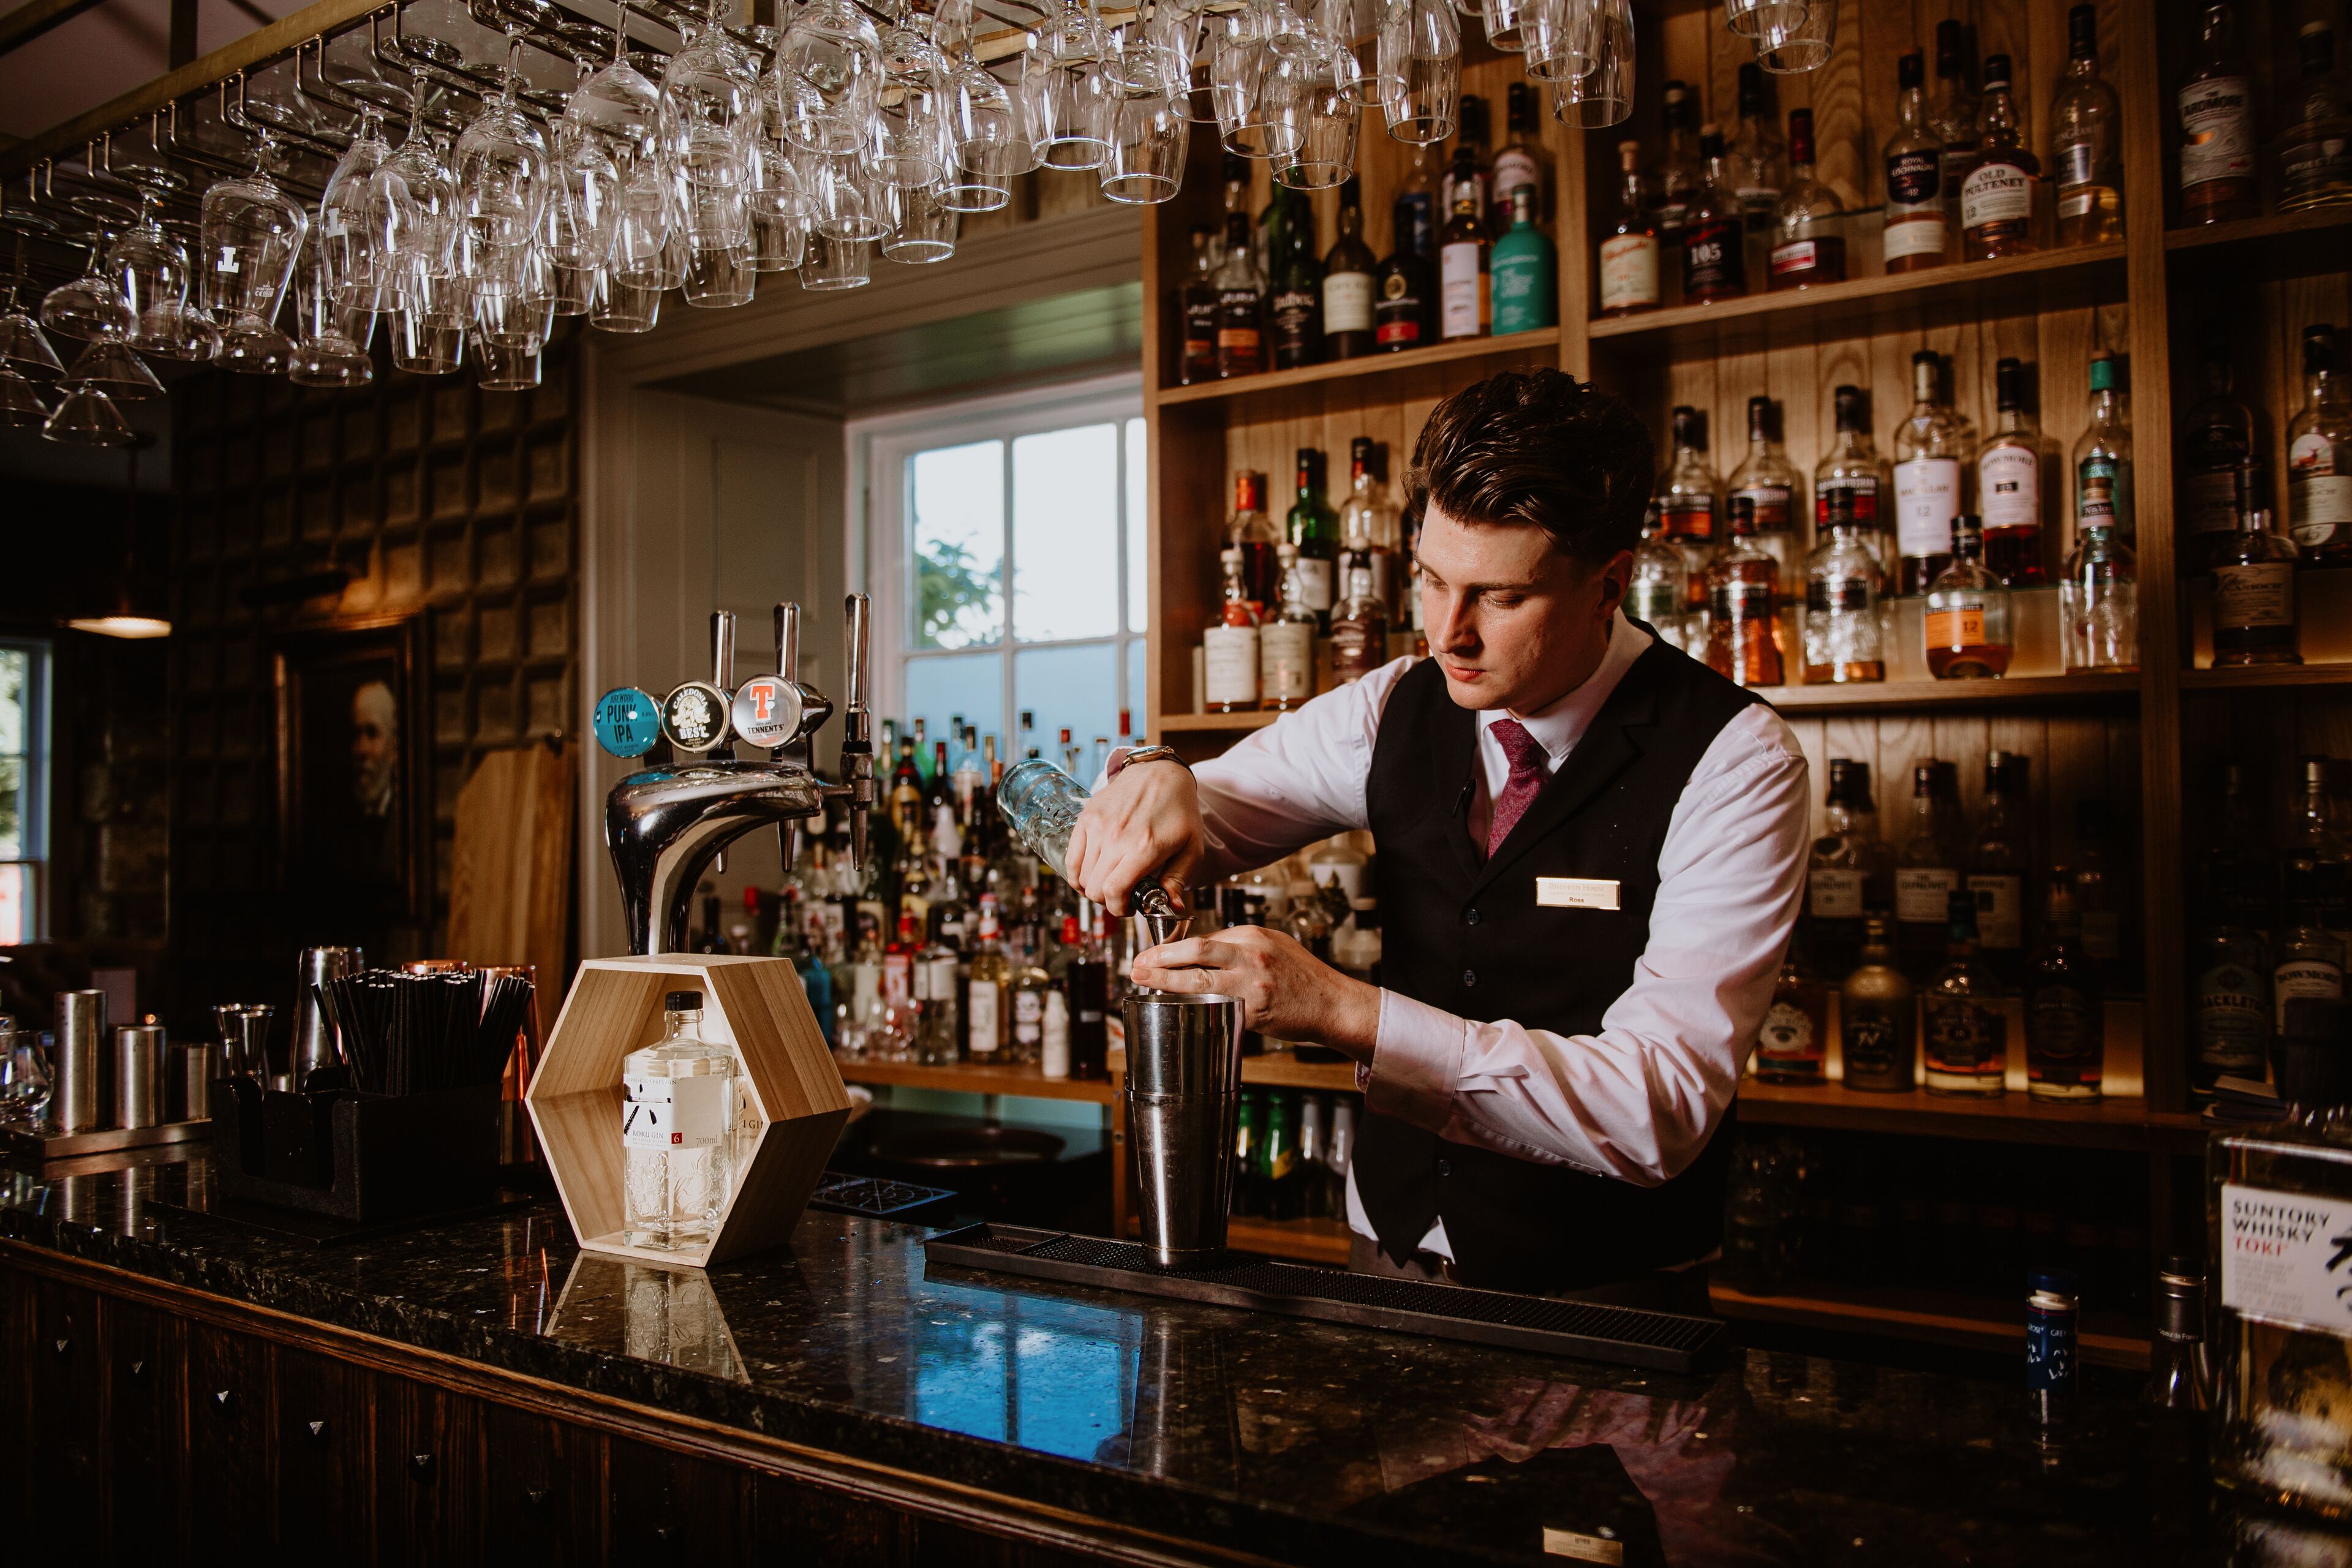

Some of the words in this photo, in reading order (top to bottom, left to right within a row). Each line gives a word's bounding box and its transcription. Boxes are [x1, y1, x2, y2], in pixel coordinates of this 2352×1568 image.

[2184, 94, 2244, 116] ARDMORE
[1901, 157, 1924, 166] ROYAL
[1979, 169, 2005, 182] OLD
[1965, 178, 2025, 197] PULTENEY
[1691, 243, 1723, 265] 105
[1983, 455, 2033, 470] BOWMORE
[1916, 506, 1931, 518] 12
[1964, 621, 1979, 633] 12
[610, 695, 634, 704] BREWDOG
[674, 688, 707, 709] CALEDONIA
[750, 684, 774, 720] T
[607, 704, 638, 724] PUNK
[614, 724, 634, 744] IPA
[679, 726, 710, 739] BEST
[673, 1134, 680, 1143] 6
[2234, 1200, 2331, 1227] SUNTORY
[2233, 1218, 2313, 1243] WHISKY
[2234, 1234, 2282, 1256] TOKI
